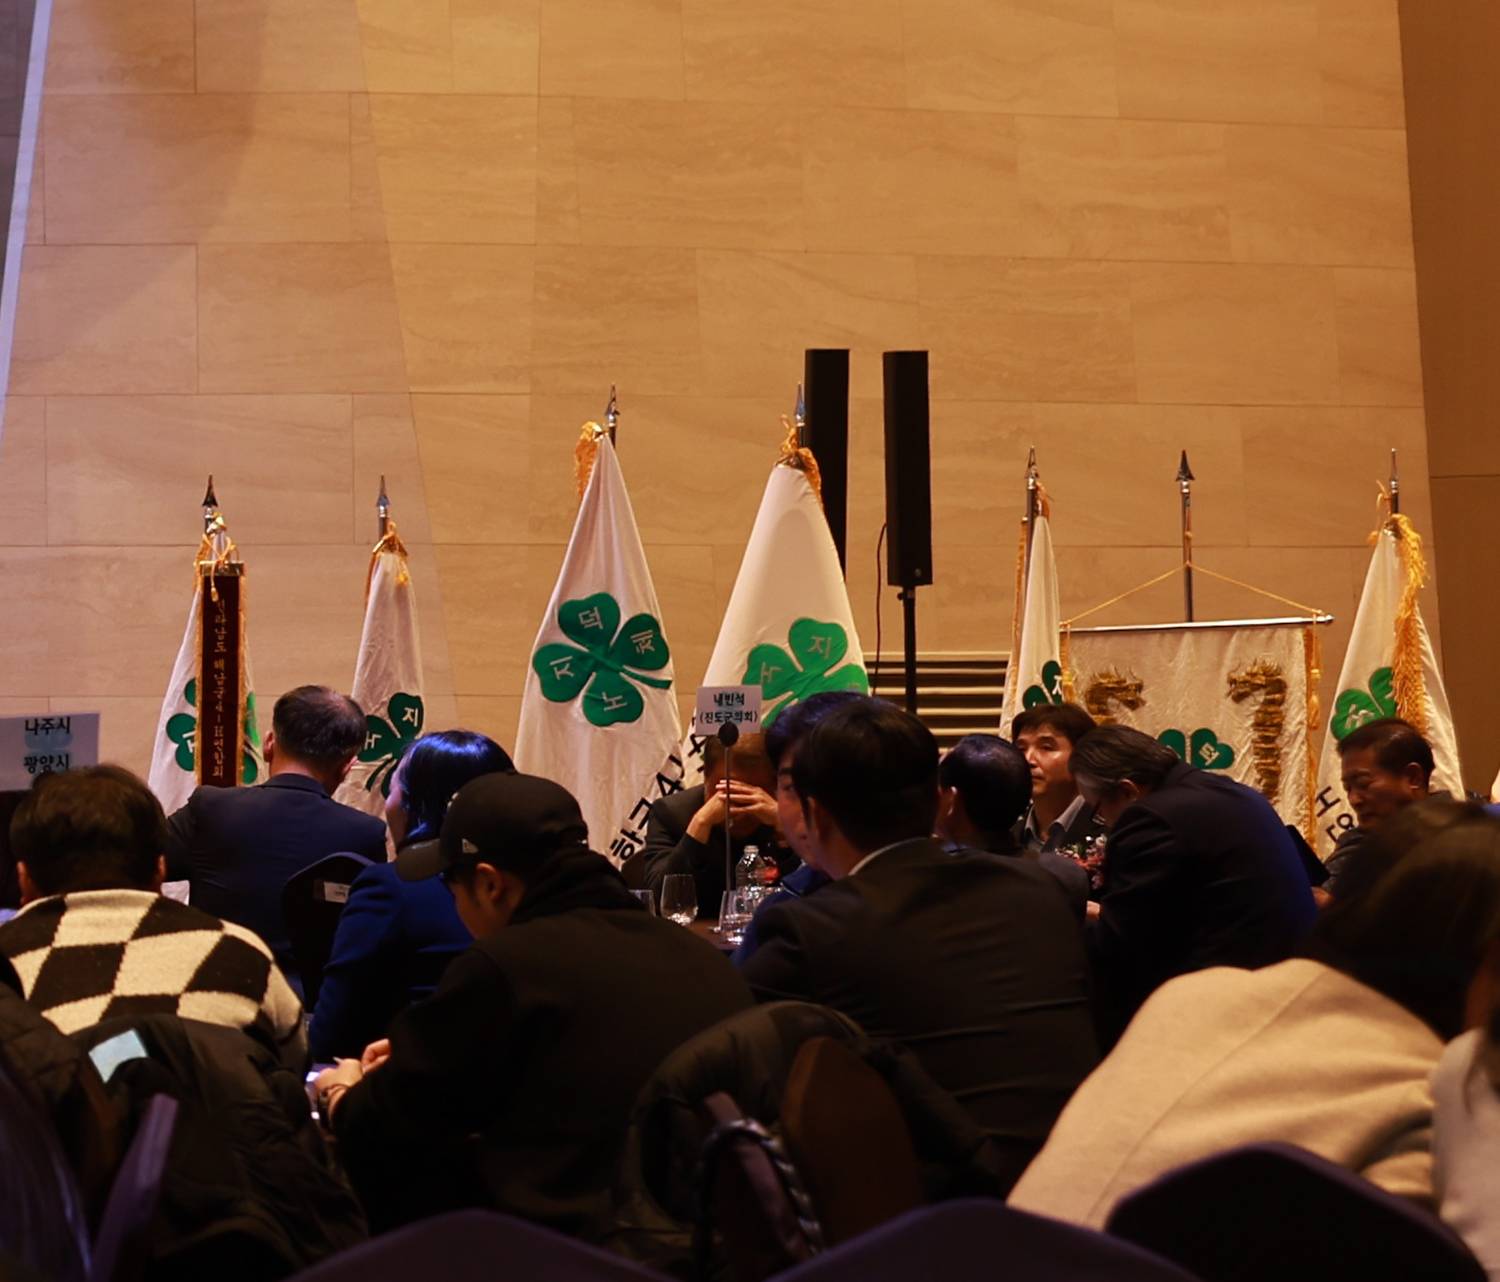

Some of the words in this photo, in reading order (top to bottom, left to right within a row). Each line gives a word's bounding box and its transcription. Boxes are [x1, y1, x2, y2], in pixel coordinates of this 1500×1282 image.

[713, 692, 745, 707] 내빈석
[25, 716, 71, 736] 나주시
[402, 707, 418, 727] 지
[23, 754, 70, 774] 광양시
